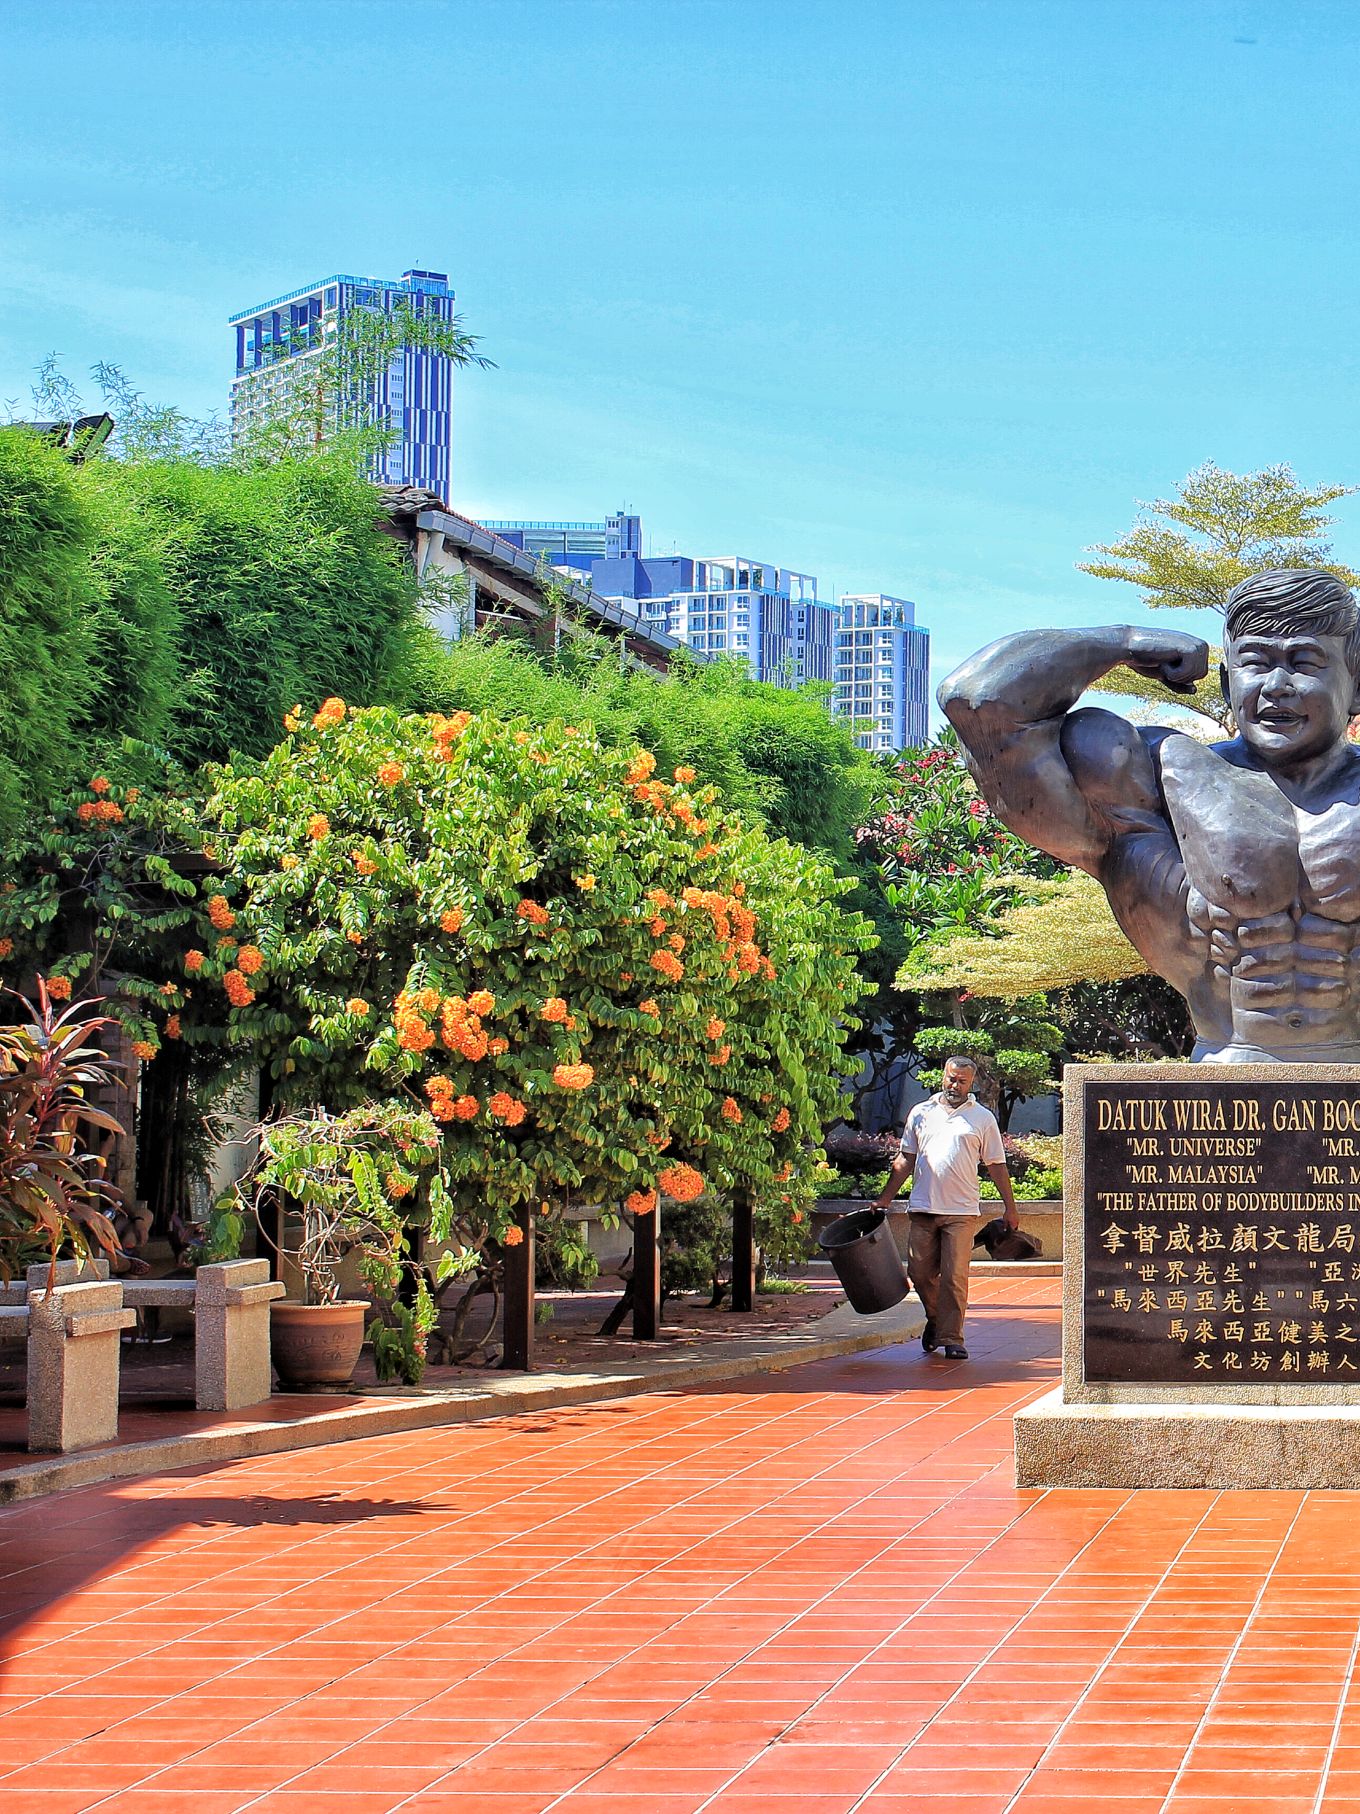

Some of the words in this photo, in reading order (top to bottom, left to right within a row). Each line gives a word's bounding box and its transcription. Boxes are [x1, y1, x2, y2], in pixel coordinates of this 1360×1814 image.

[1098, 1099, 1166, 1131] DATUK
[1173, 1099, 1226, 1131] WIRA
[1233, 1099, 1266, 1131] DR.
[1273, 1099, 1316, 1132] GAN
[1126, 1137, 1164, 1156] "MR.
[1169, 1137, 1262, 1157] UNIVERSE"
[1322, 1137, 1360, 1156] "MR.
[1126, 1165, 1163, 1184] "MR.
[1168, 1165, 1263, 1184] MALAYSIA"
[1306, 1165, 1345, 1185] "MR.
[1097, 1192, 1134, 1211] "THE
[1138, 1192, 1198, 1211] FATHER
[1202, 1192, 1223, 1212] OF
[1227, 1192, 1344, 1212] BODYBUILDERS
